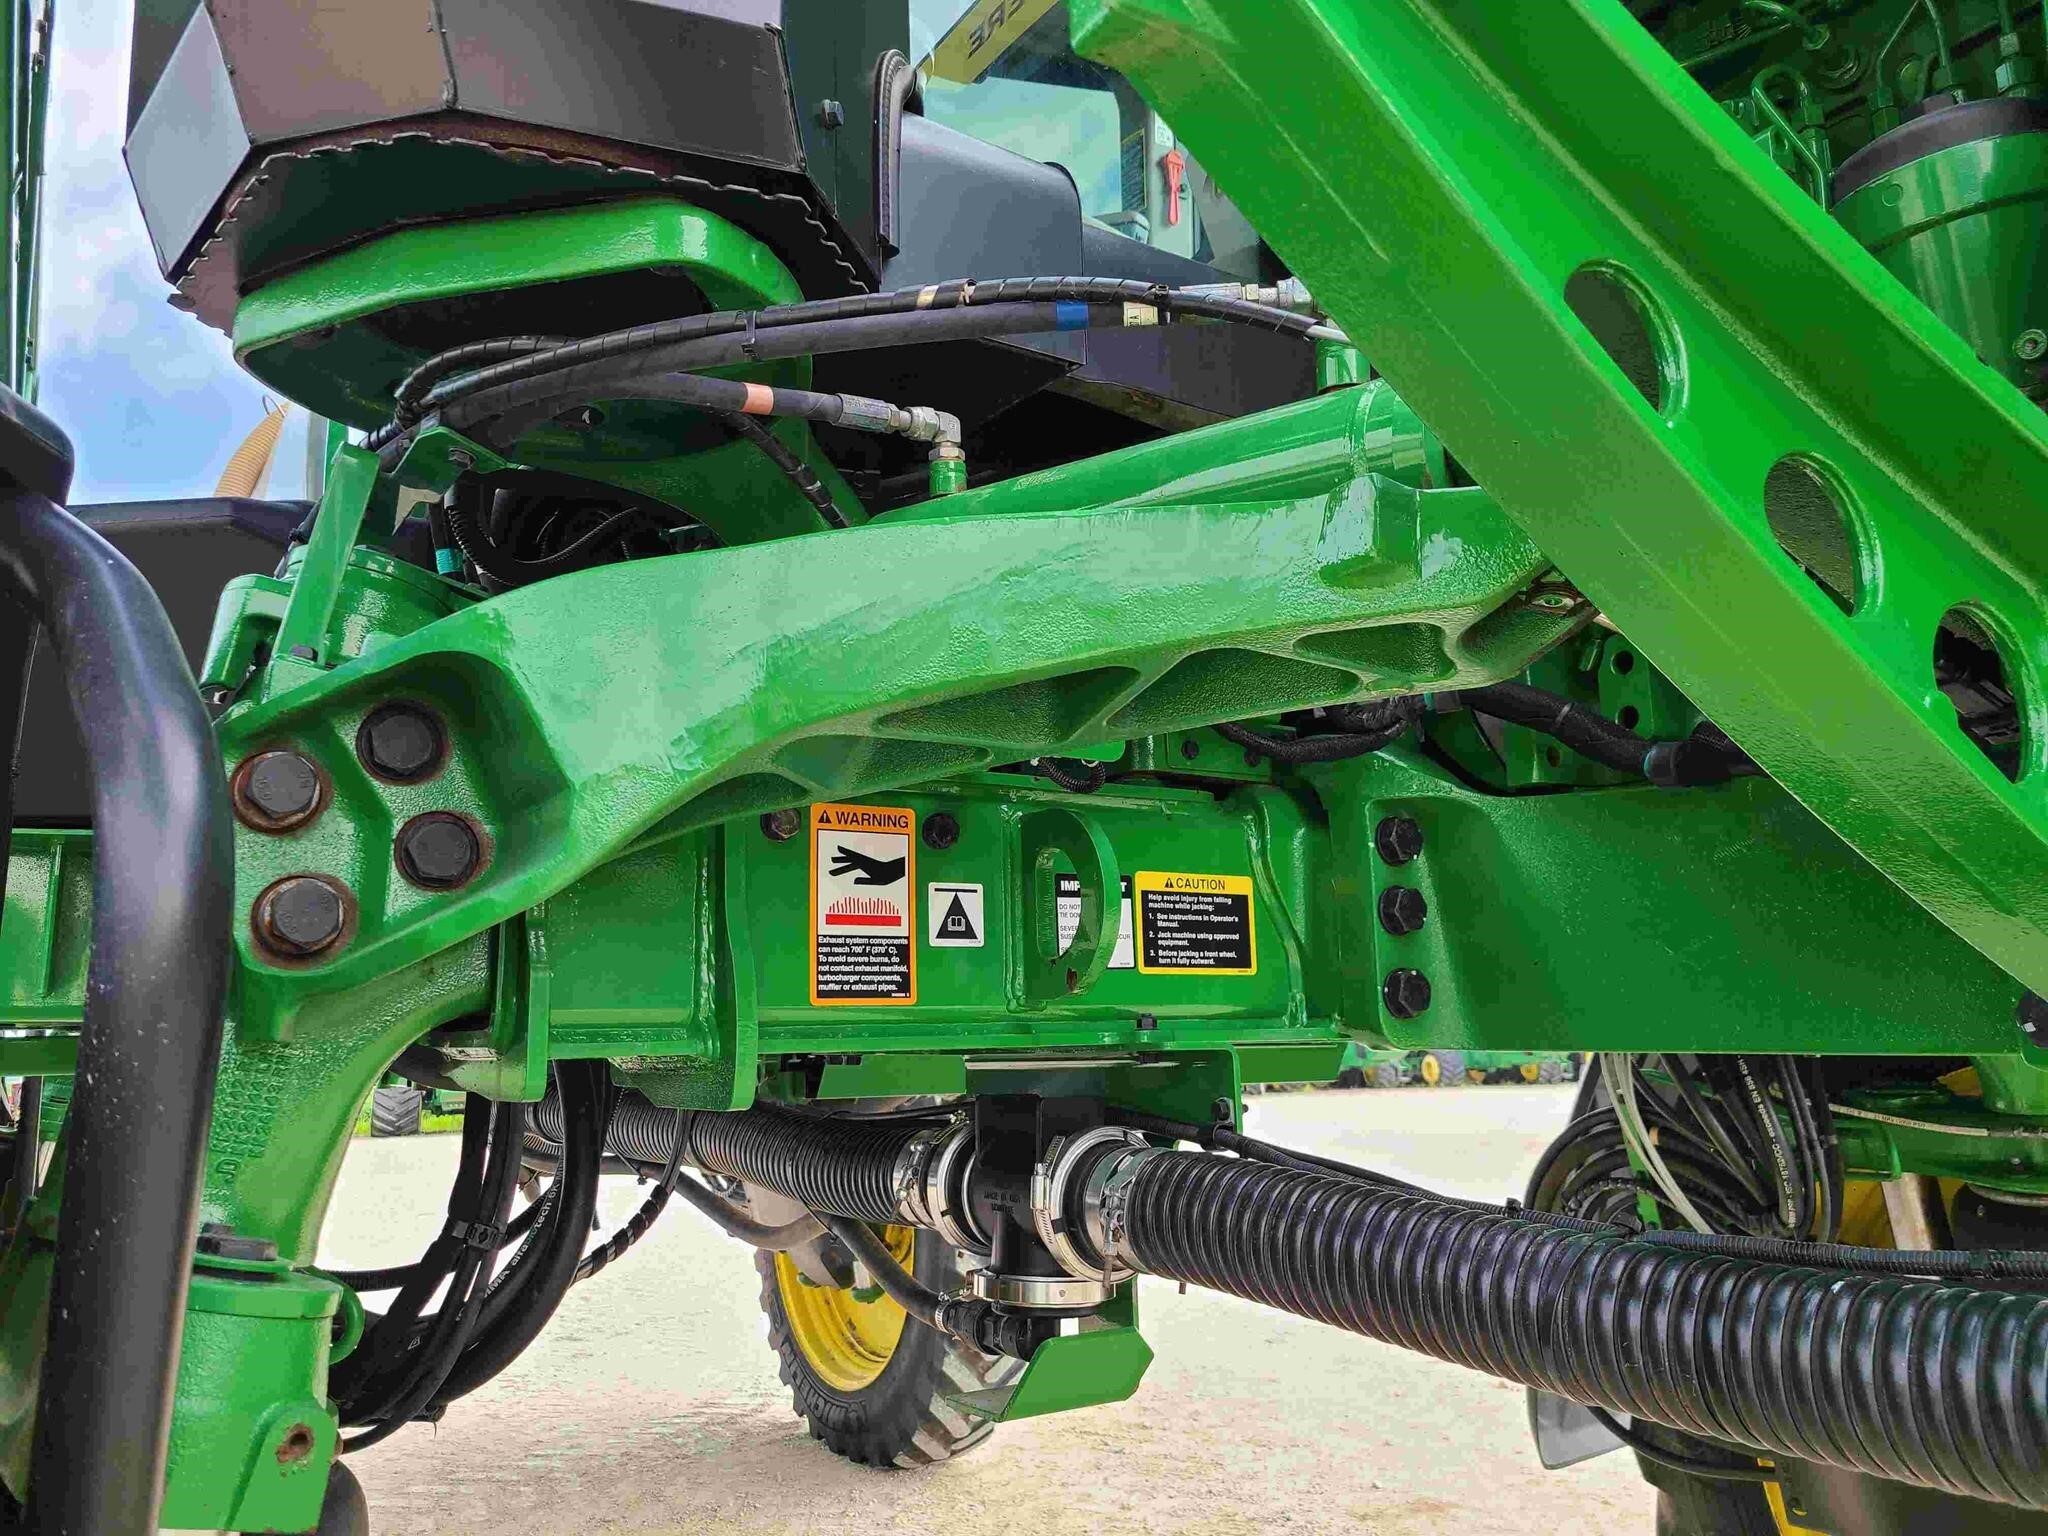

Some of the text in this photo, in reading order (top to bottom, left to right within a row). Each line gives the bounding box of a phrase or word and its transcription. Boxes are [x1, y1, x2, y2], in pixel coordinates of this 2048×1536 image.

[836, 811, 909, 829] WARNING
[1176, 878, 1226, 890] CAUTION
[1181, 895, 1198, 903] injury
[1214, 897, 1232, 905] falling
[818, 936, 845, 944] Exhaust
[846, 937, 868, 945] system
[1214, 933, 1240, 941] approved
[870, 956, 890, 964] burns,
[880, 965, 908, 973] manifold,
[818, 974, 860, 982] turbocharger
[879, 984, 898, 992] pipes.
